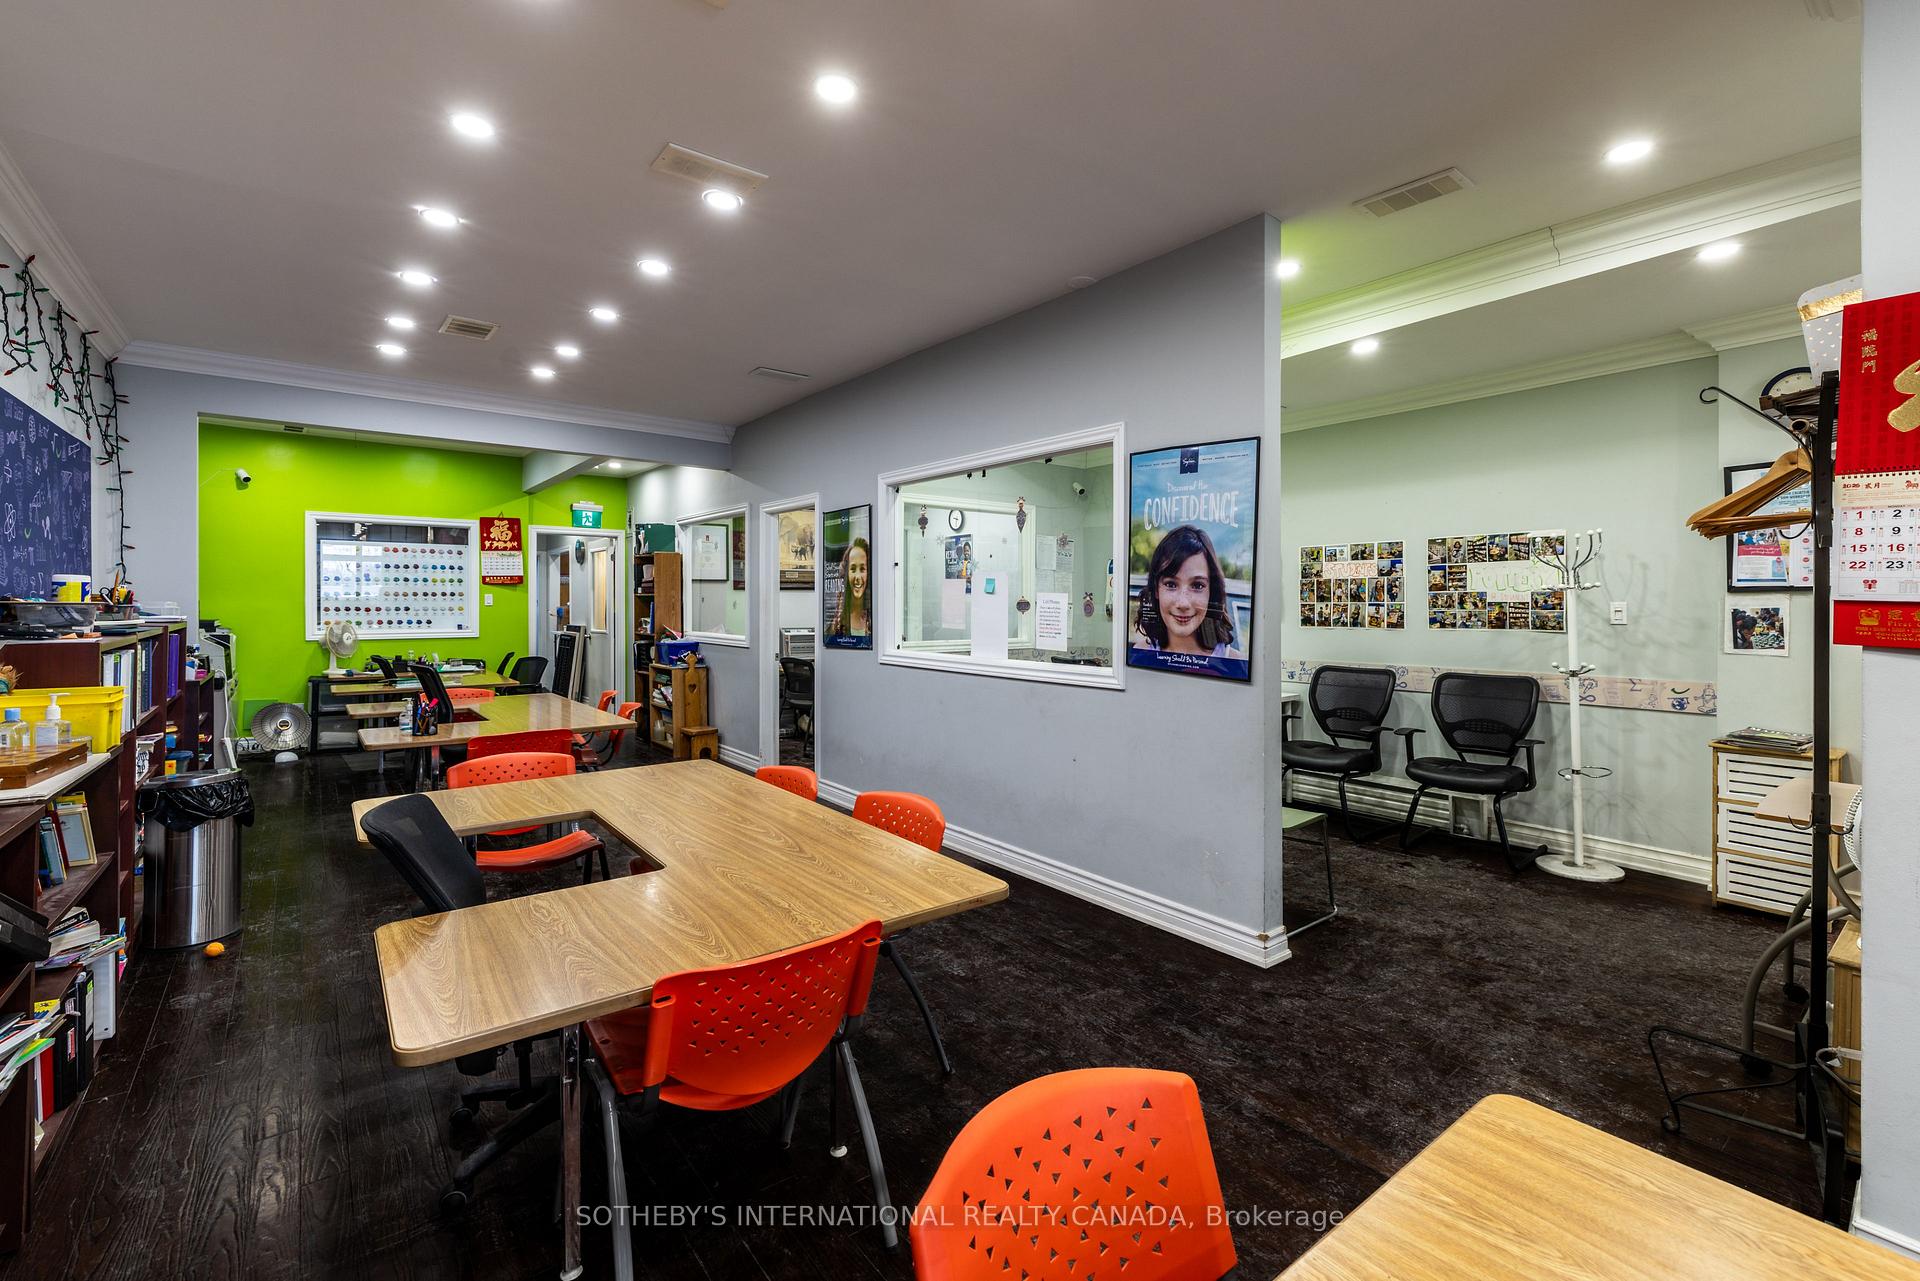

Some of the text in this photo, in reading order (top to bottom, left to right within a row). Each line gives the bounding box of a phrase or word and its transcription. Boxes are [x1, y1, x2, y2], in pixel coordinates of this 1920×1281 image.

[1144, 491, 1239, 531] CONFIDENCE
[1856, 509, 1902, 519] 1 2
[1854, 526, 1901, 536] 8 9
[1850, 543, 1905, 552] 15 16
[1849, 560, 1904, 569] 22 23
[1323, 562, 1377, 578] STUDENTS
